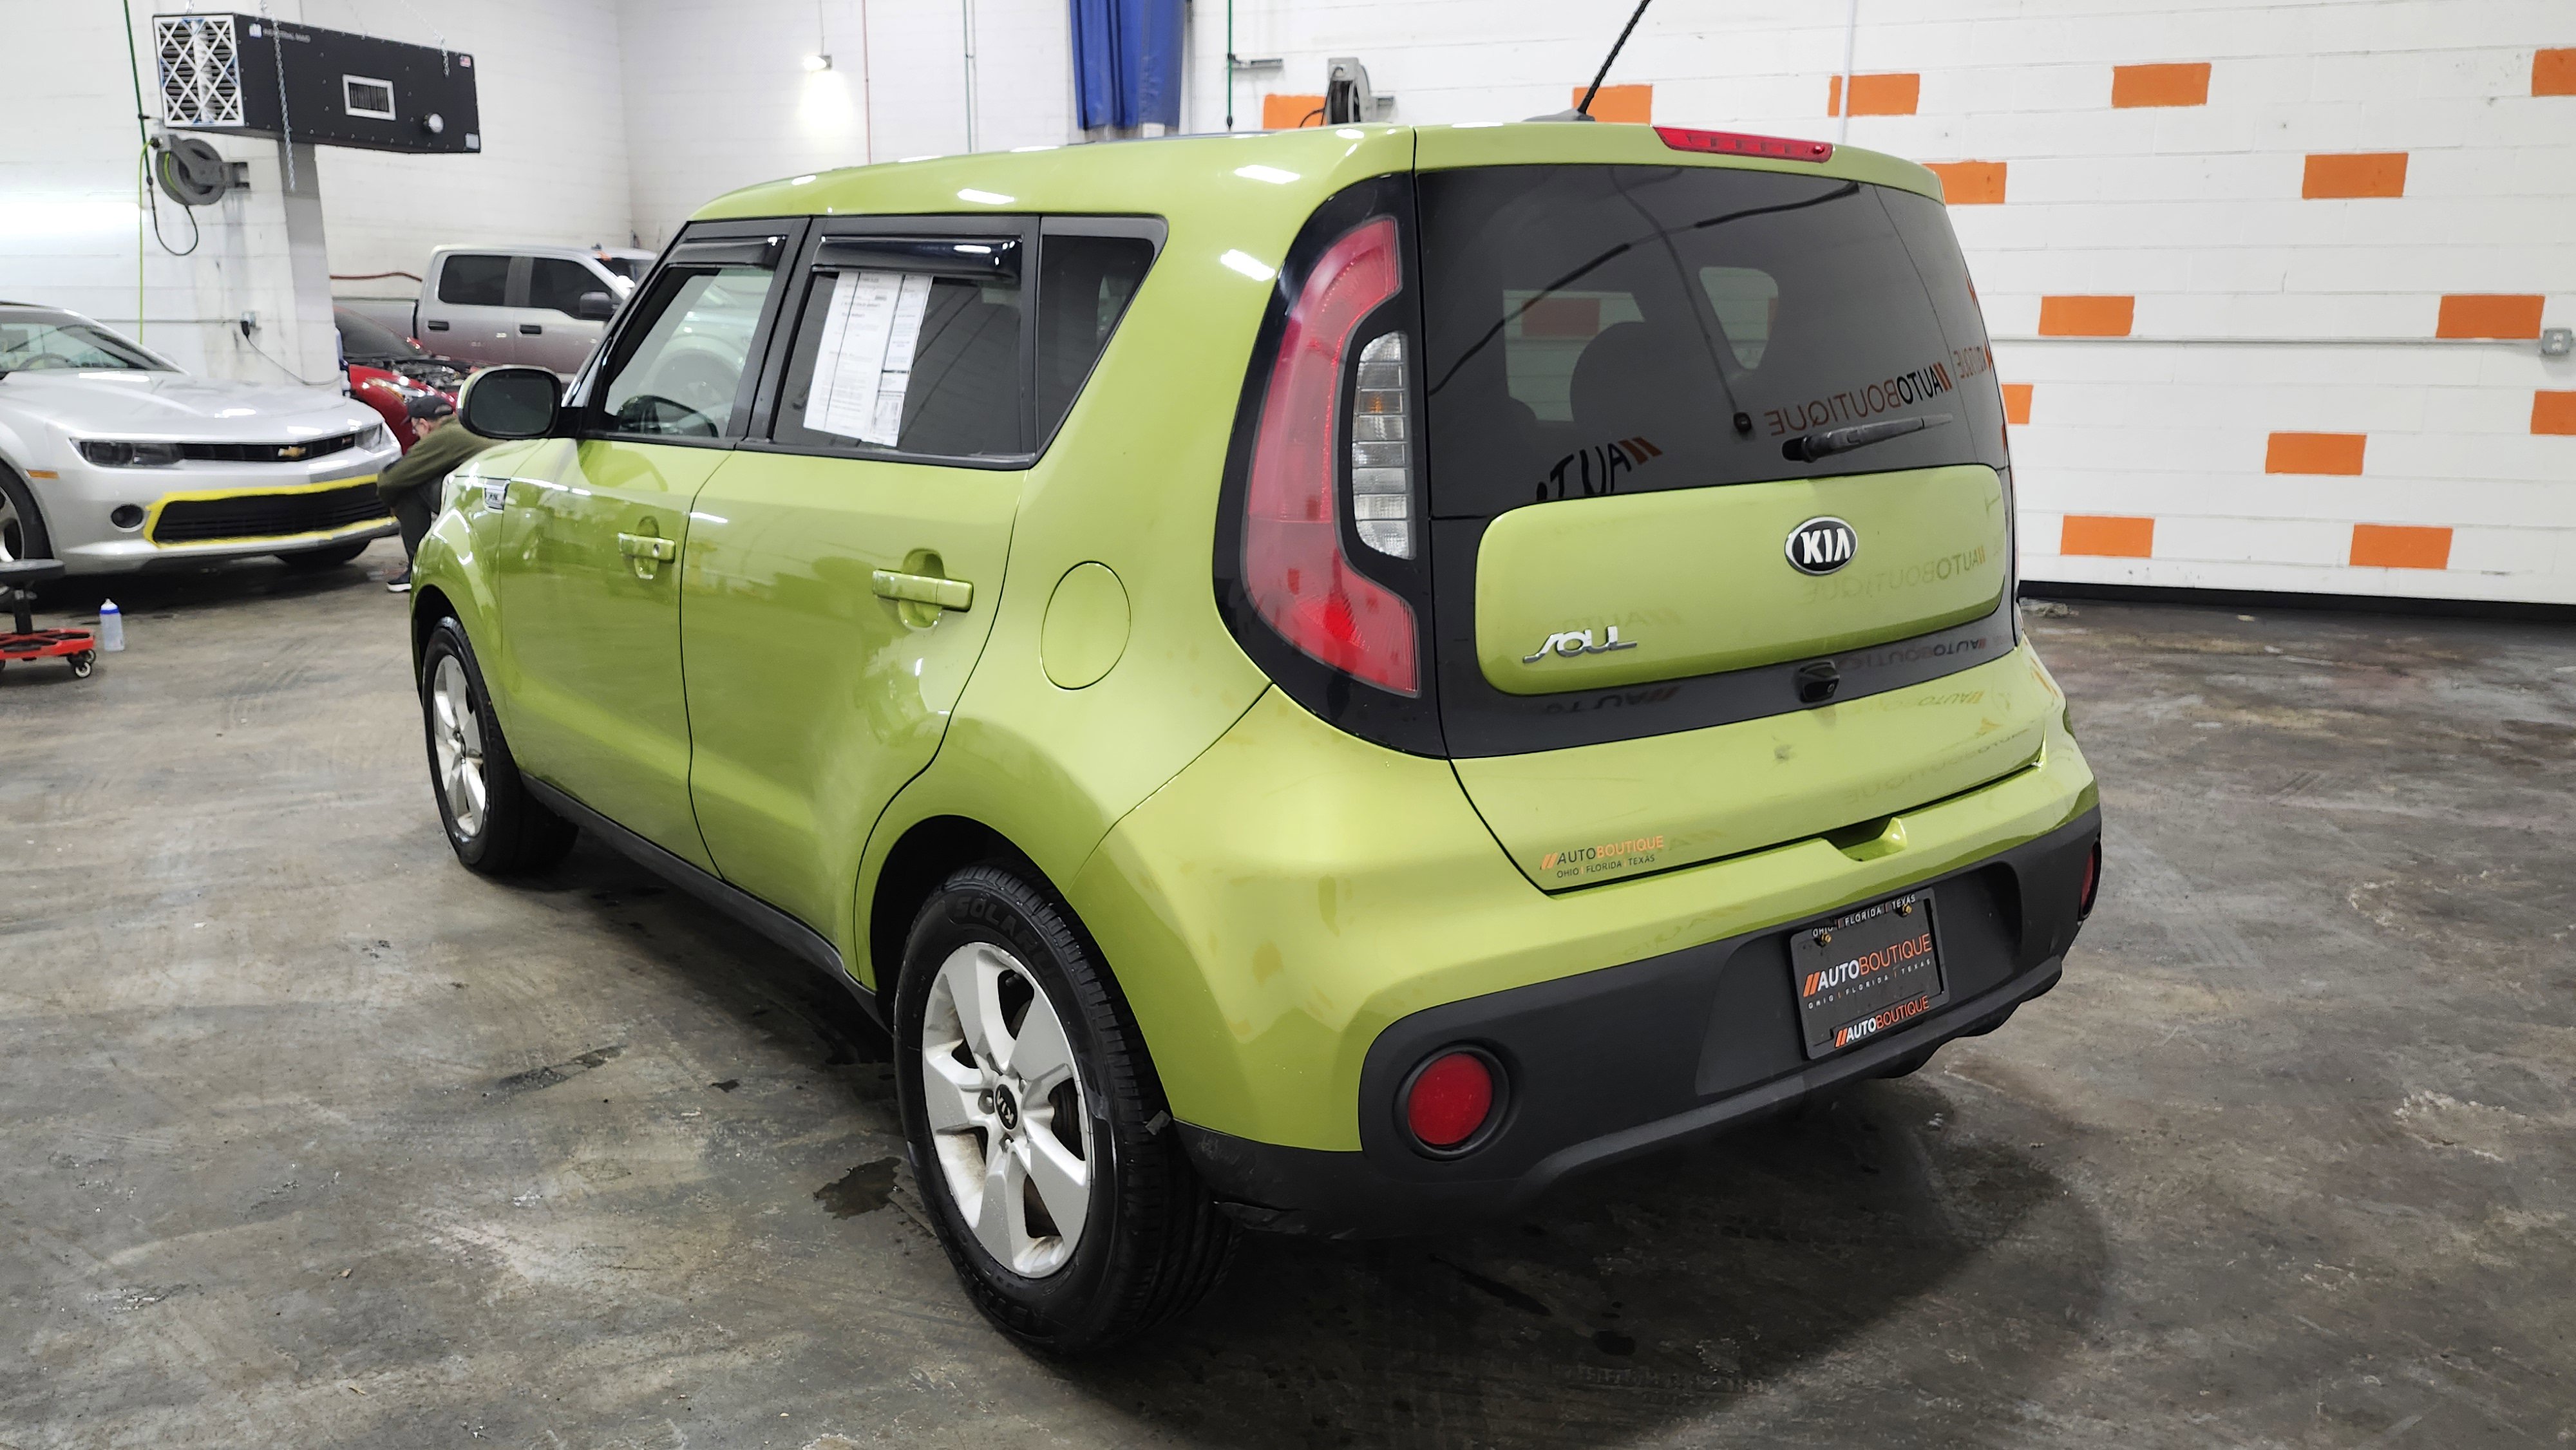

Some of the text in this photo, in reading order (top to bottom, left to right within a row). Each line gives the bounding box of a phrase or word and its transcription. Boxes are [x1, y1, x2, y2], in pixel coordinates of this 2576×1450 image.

[1801, 527, 1851, 564] KIA
[1522, 625, 1638, 664] SOUL
[1556, 835, 1664, 866] AUTOBOUTIQUE
[1557, 854, 1655, 878] OHIO FLORIDA TEXAS
[1844, 908, 1882, 927] FLORIDA
[1891, 894, 1916, 910] TEXAS
[1817, 933, 1933, 992] AUTOBOUTIQUE
[1808, 957, 1931, 1009] OHIO FLORIDA TEXAS
[1845, 995, 1930, 1043] AUTOBOUTIQUE
